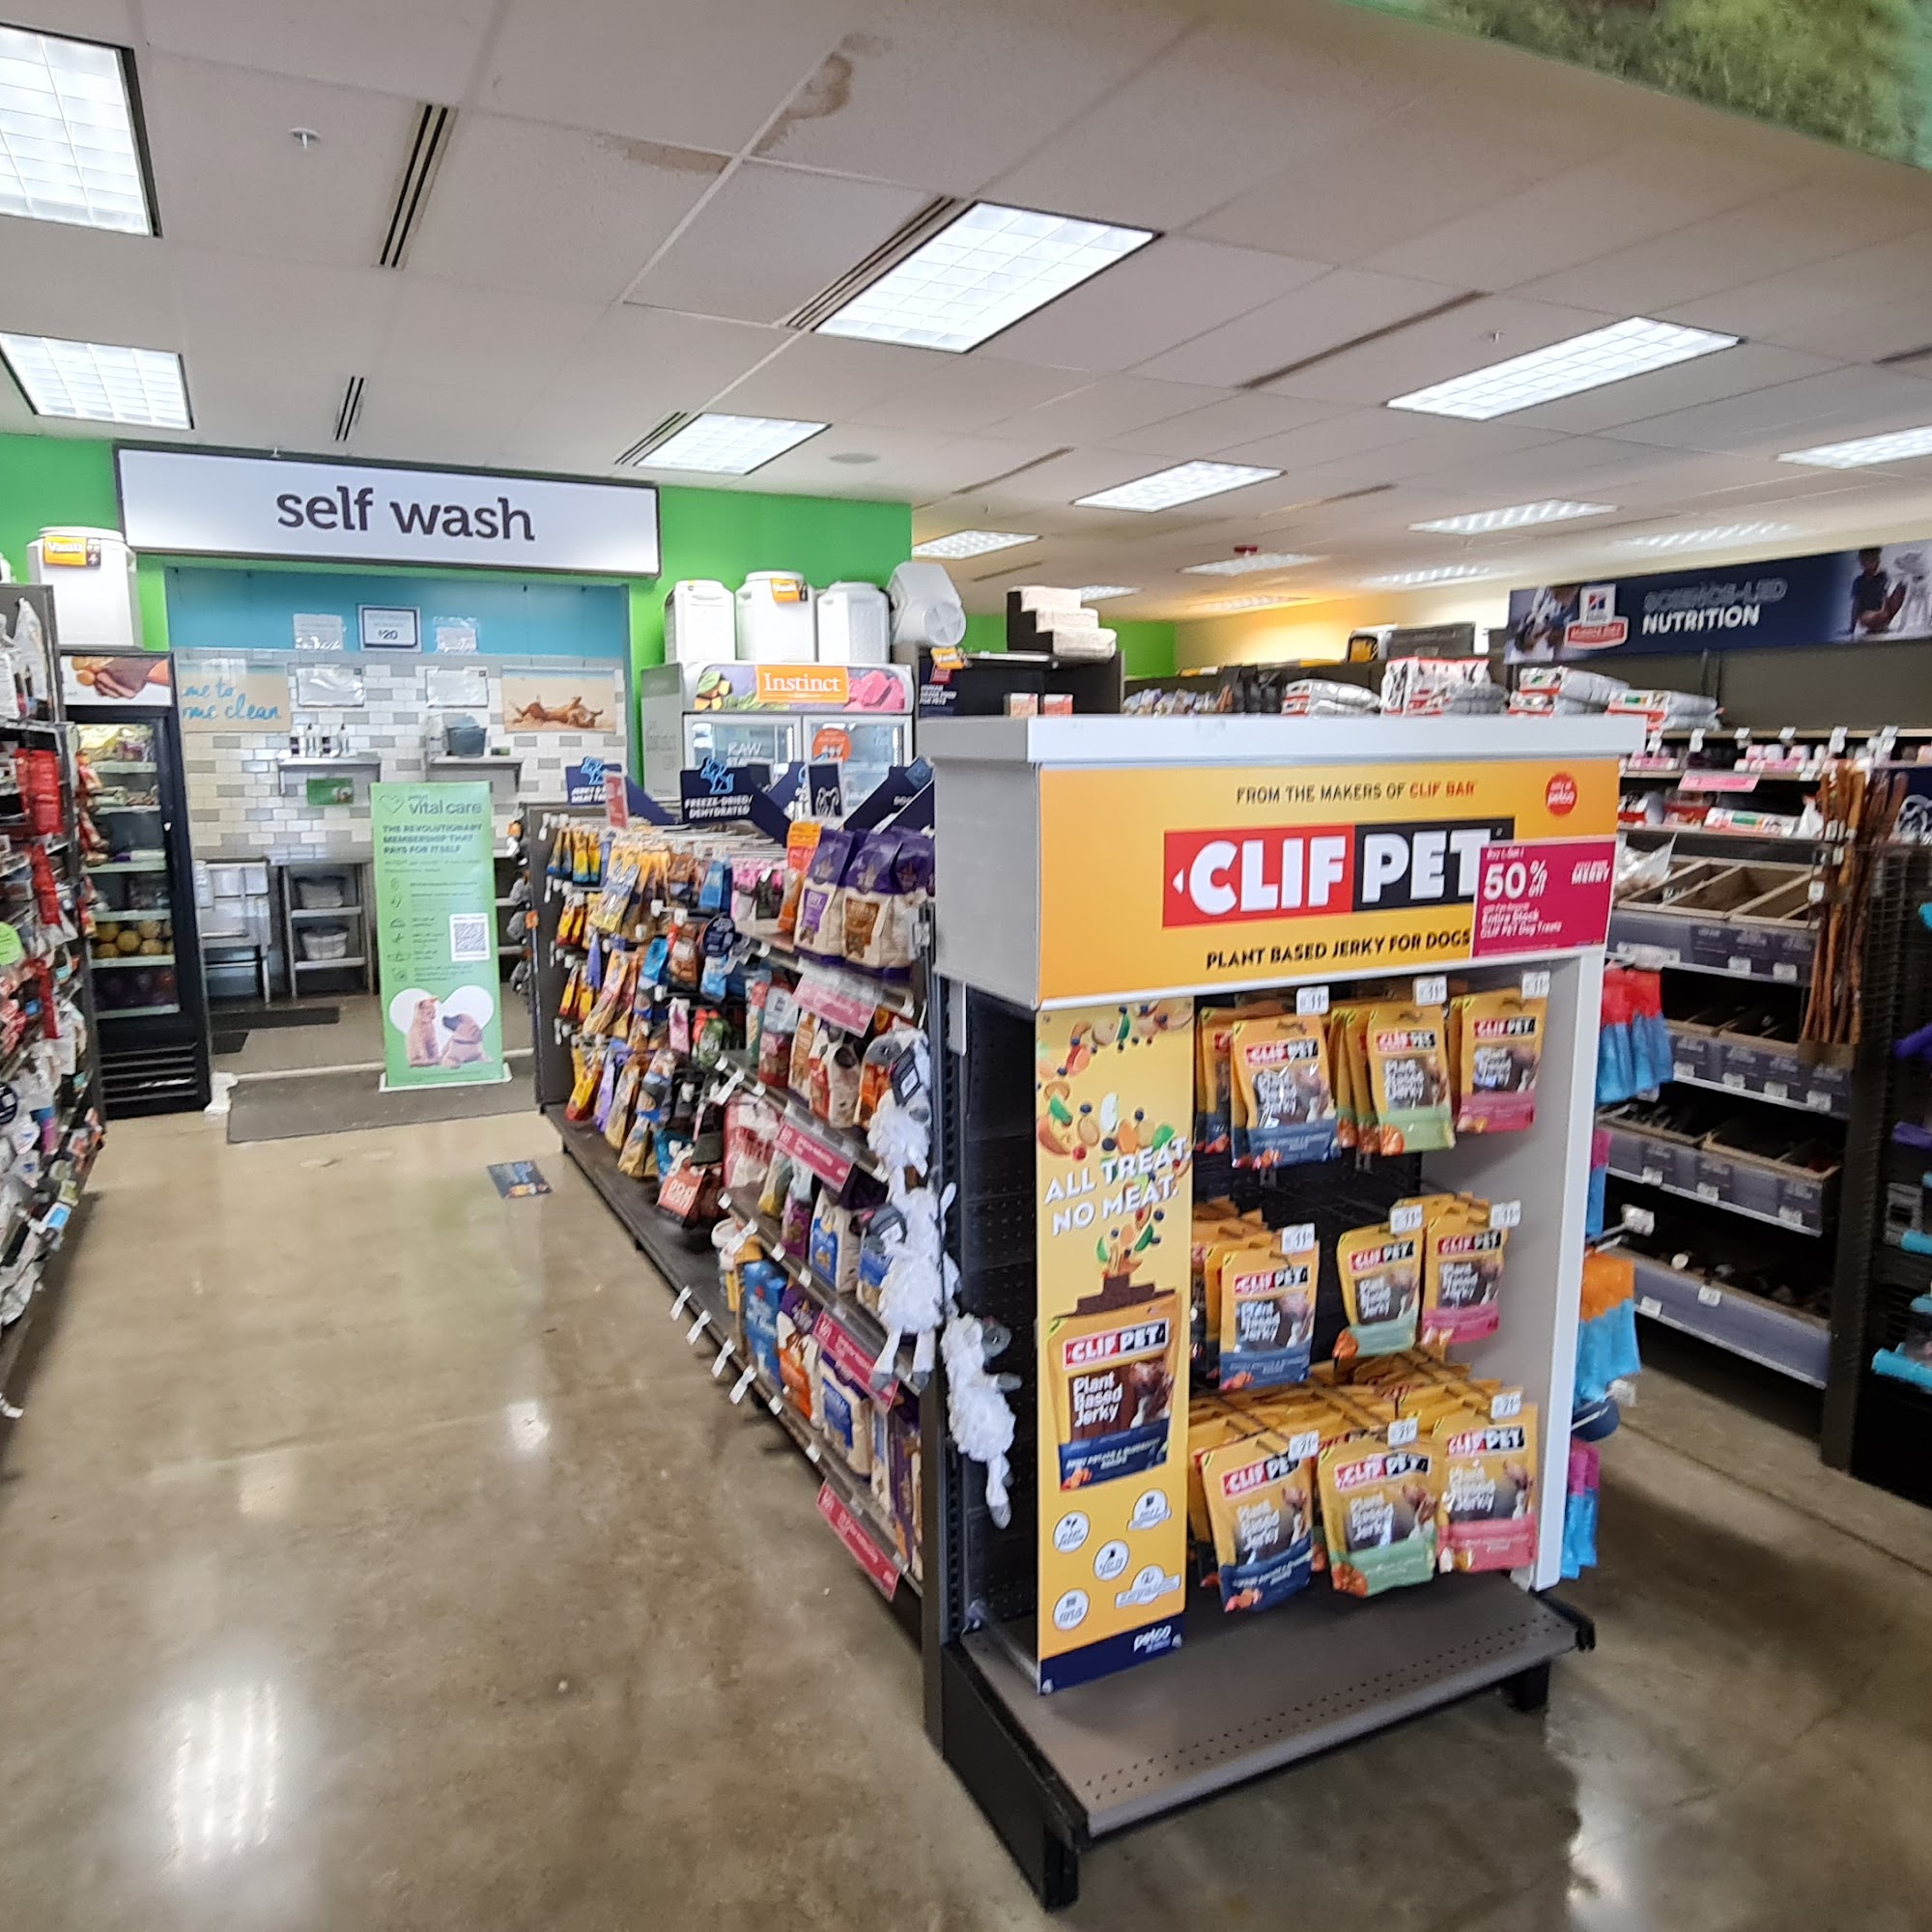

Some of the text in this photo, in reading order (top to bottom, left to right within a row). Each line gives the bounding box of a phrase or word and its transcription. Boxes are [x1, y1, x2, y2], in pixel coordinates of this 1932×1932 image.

[276, 485, 536, 541] self wash
[1642, 604, 1761, 636] NUTRITION
[763, 672, 842, 693] Instinct
[224, 692, 282, 721] clean
[727, 742, 762, 756] RAW
[1236, 780, 1475, 805] FROM THE MAKERS OF CLIF BAR
[410, 799, 482, 814] vital care
[689, 805, 751, 819] DEHYDRATED
[1189, 828, 1492, 917] CLIF PET
[1207, 927, 1471, 969] PLANT BASED JERKY FOR DOGS
[1043, 1168, 1096, 1206] ALL
[1053, 1202, 1096, 1236] NO
[1121, 1325, 1159, 1352] PET
[1073, 1371, 1116, 1394] Plant
[1074, 1404, 1120, 1428] Jerky
